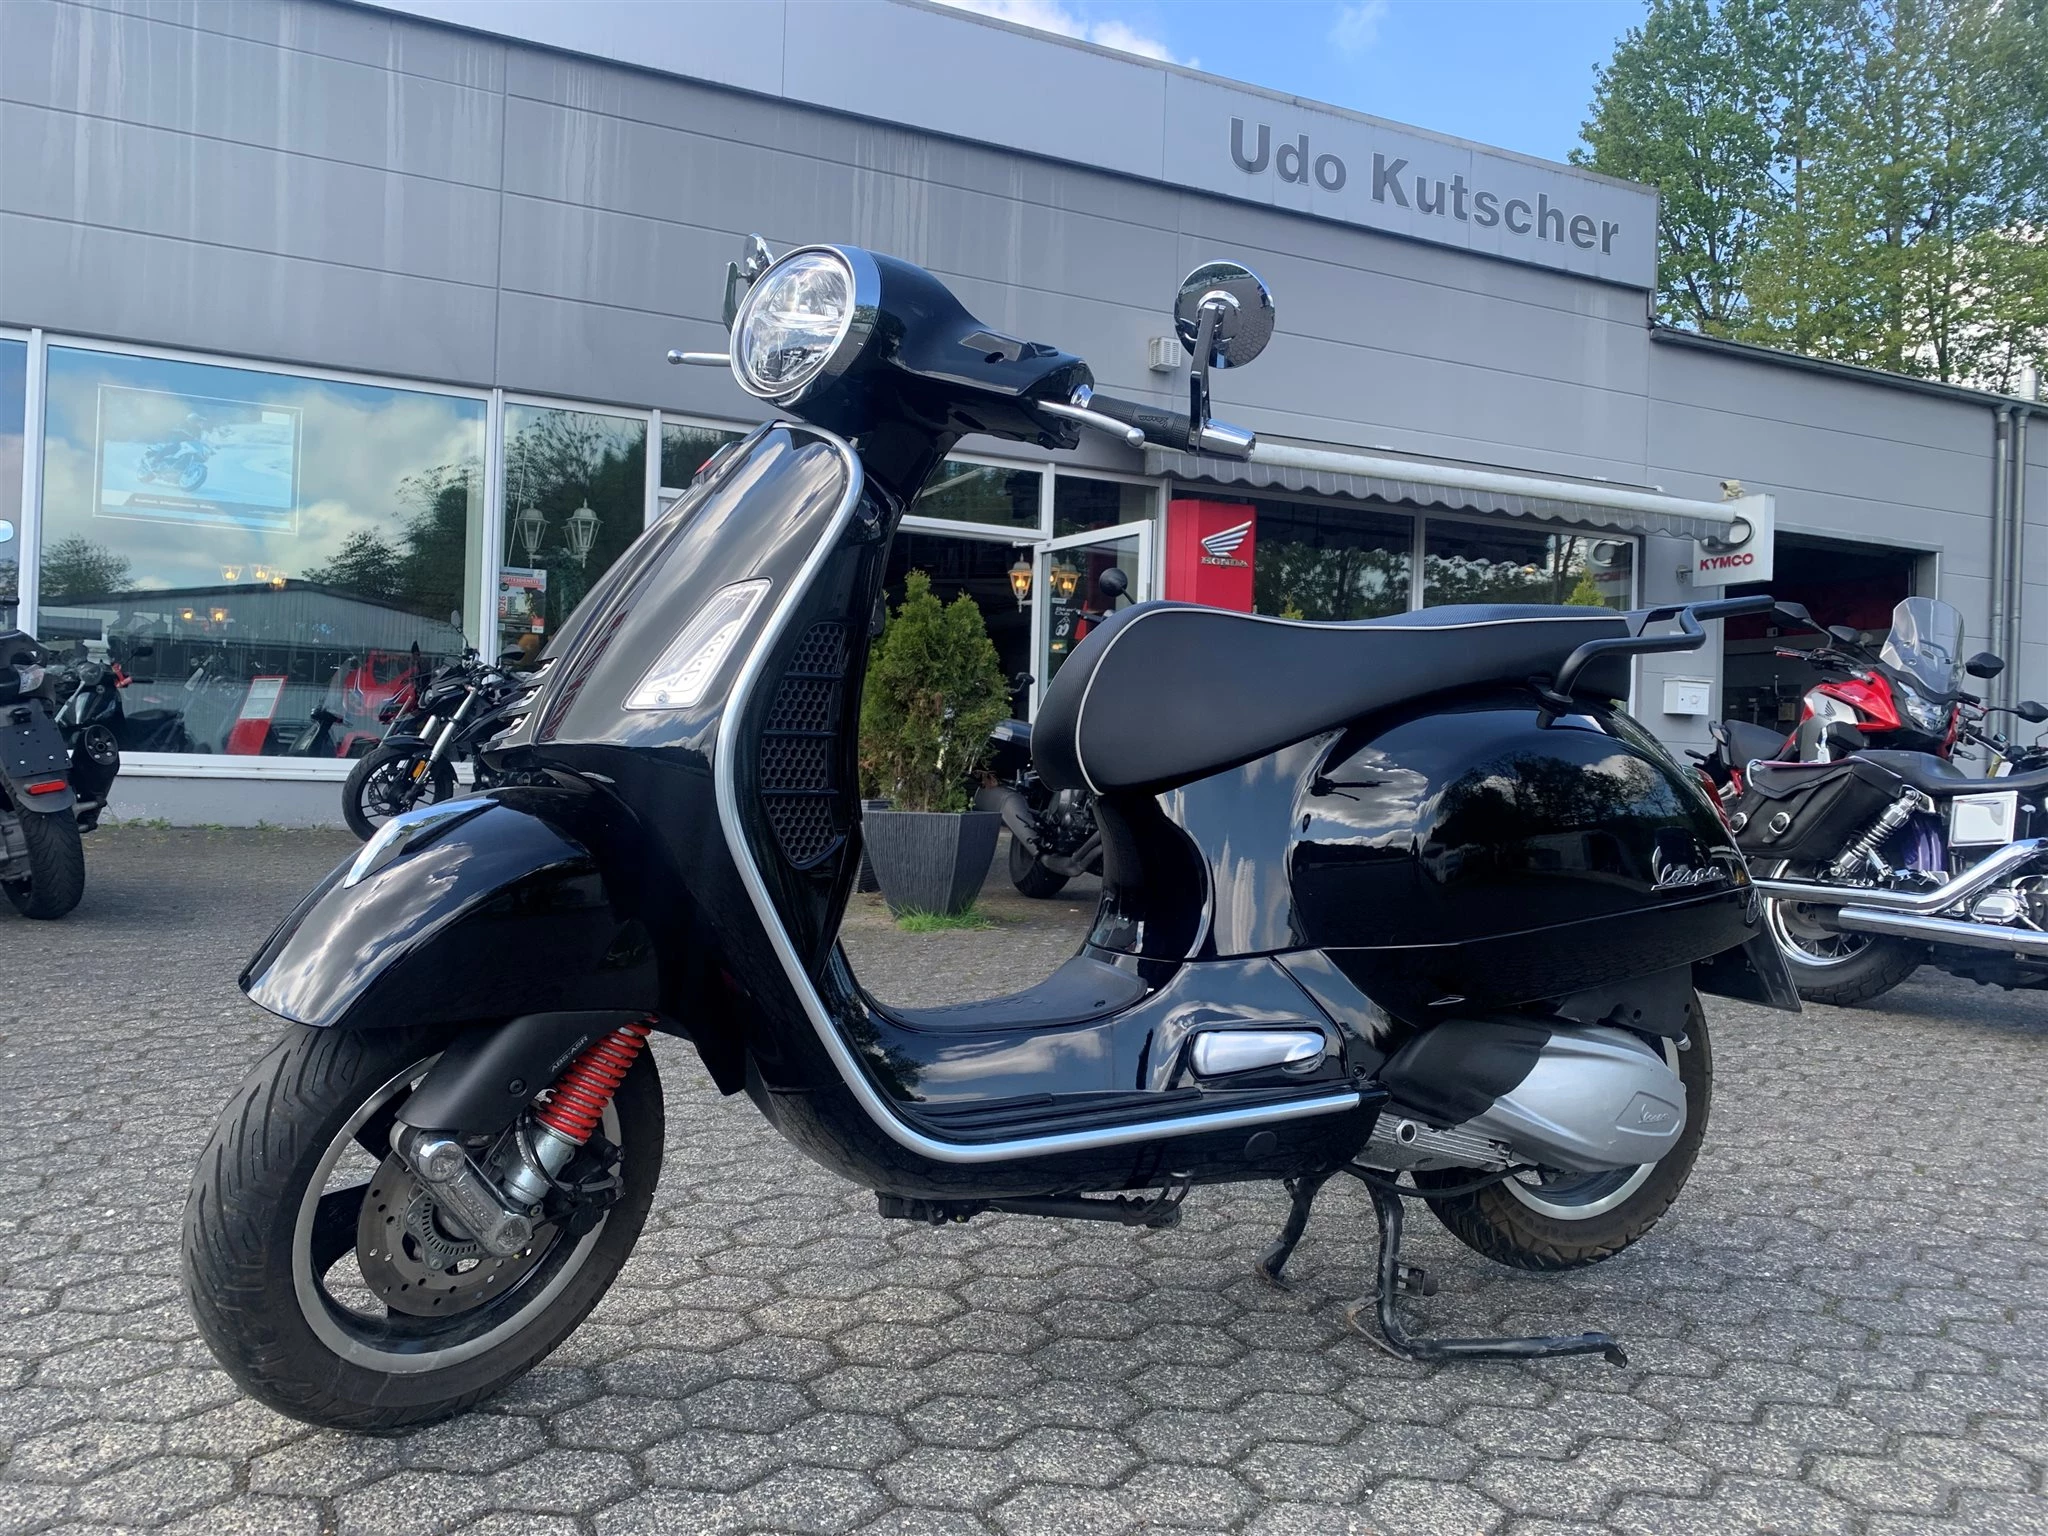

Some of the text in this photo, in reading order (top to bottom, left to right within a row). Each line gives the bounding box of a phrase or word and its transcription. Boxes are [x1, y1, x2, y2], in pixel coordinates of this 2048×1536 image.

[1229, 116, 1620, 255] Udo Kutscher
[1201, 557, 1249, 568] HONDA
[1700, 553, 1754, 572] KYMCO
[1651, 845, 1727, 891] Vespa
